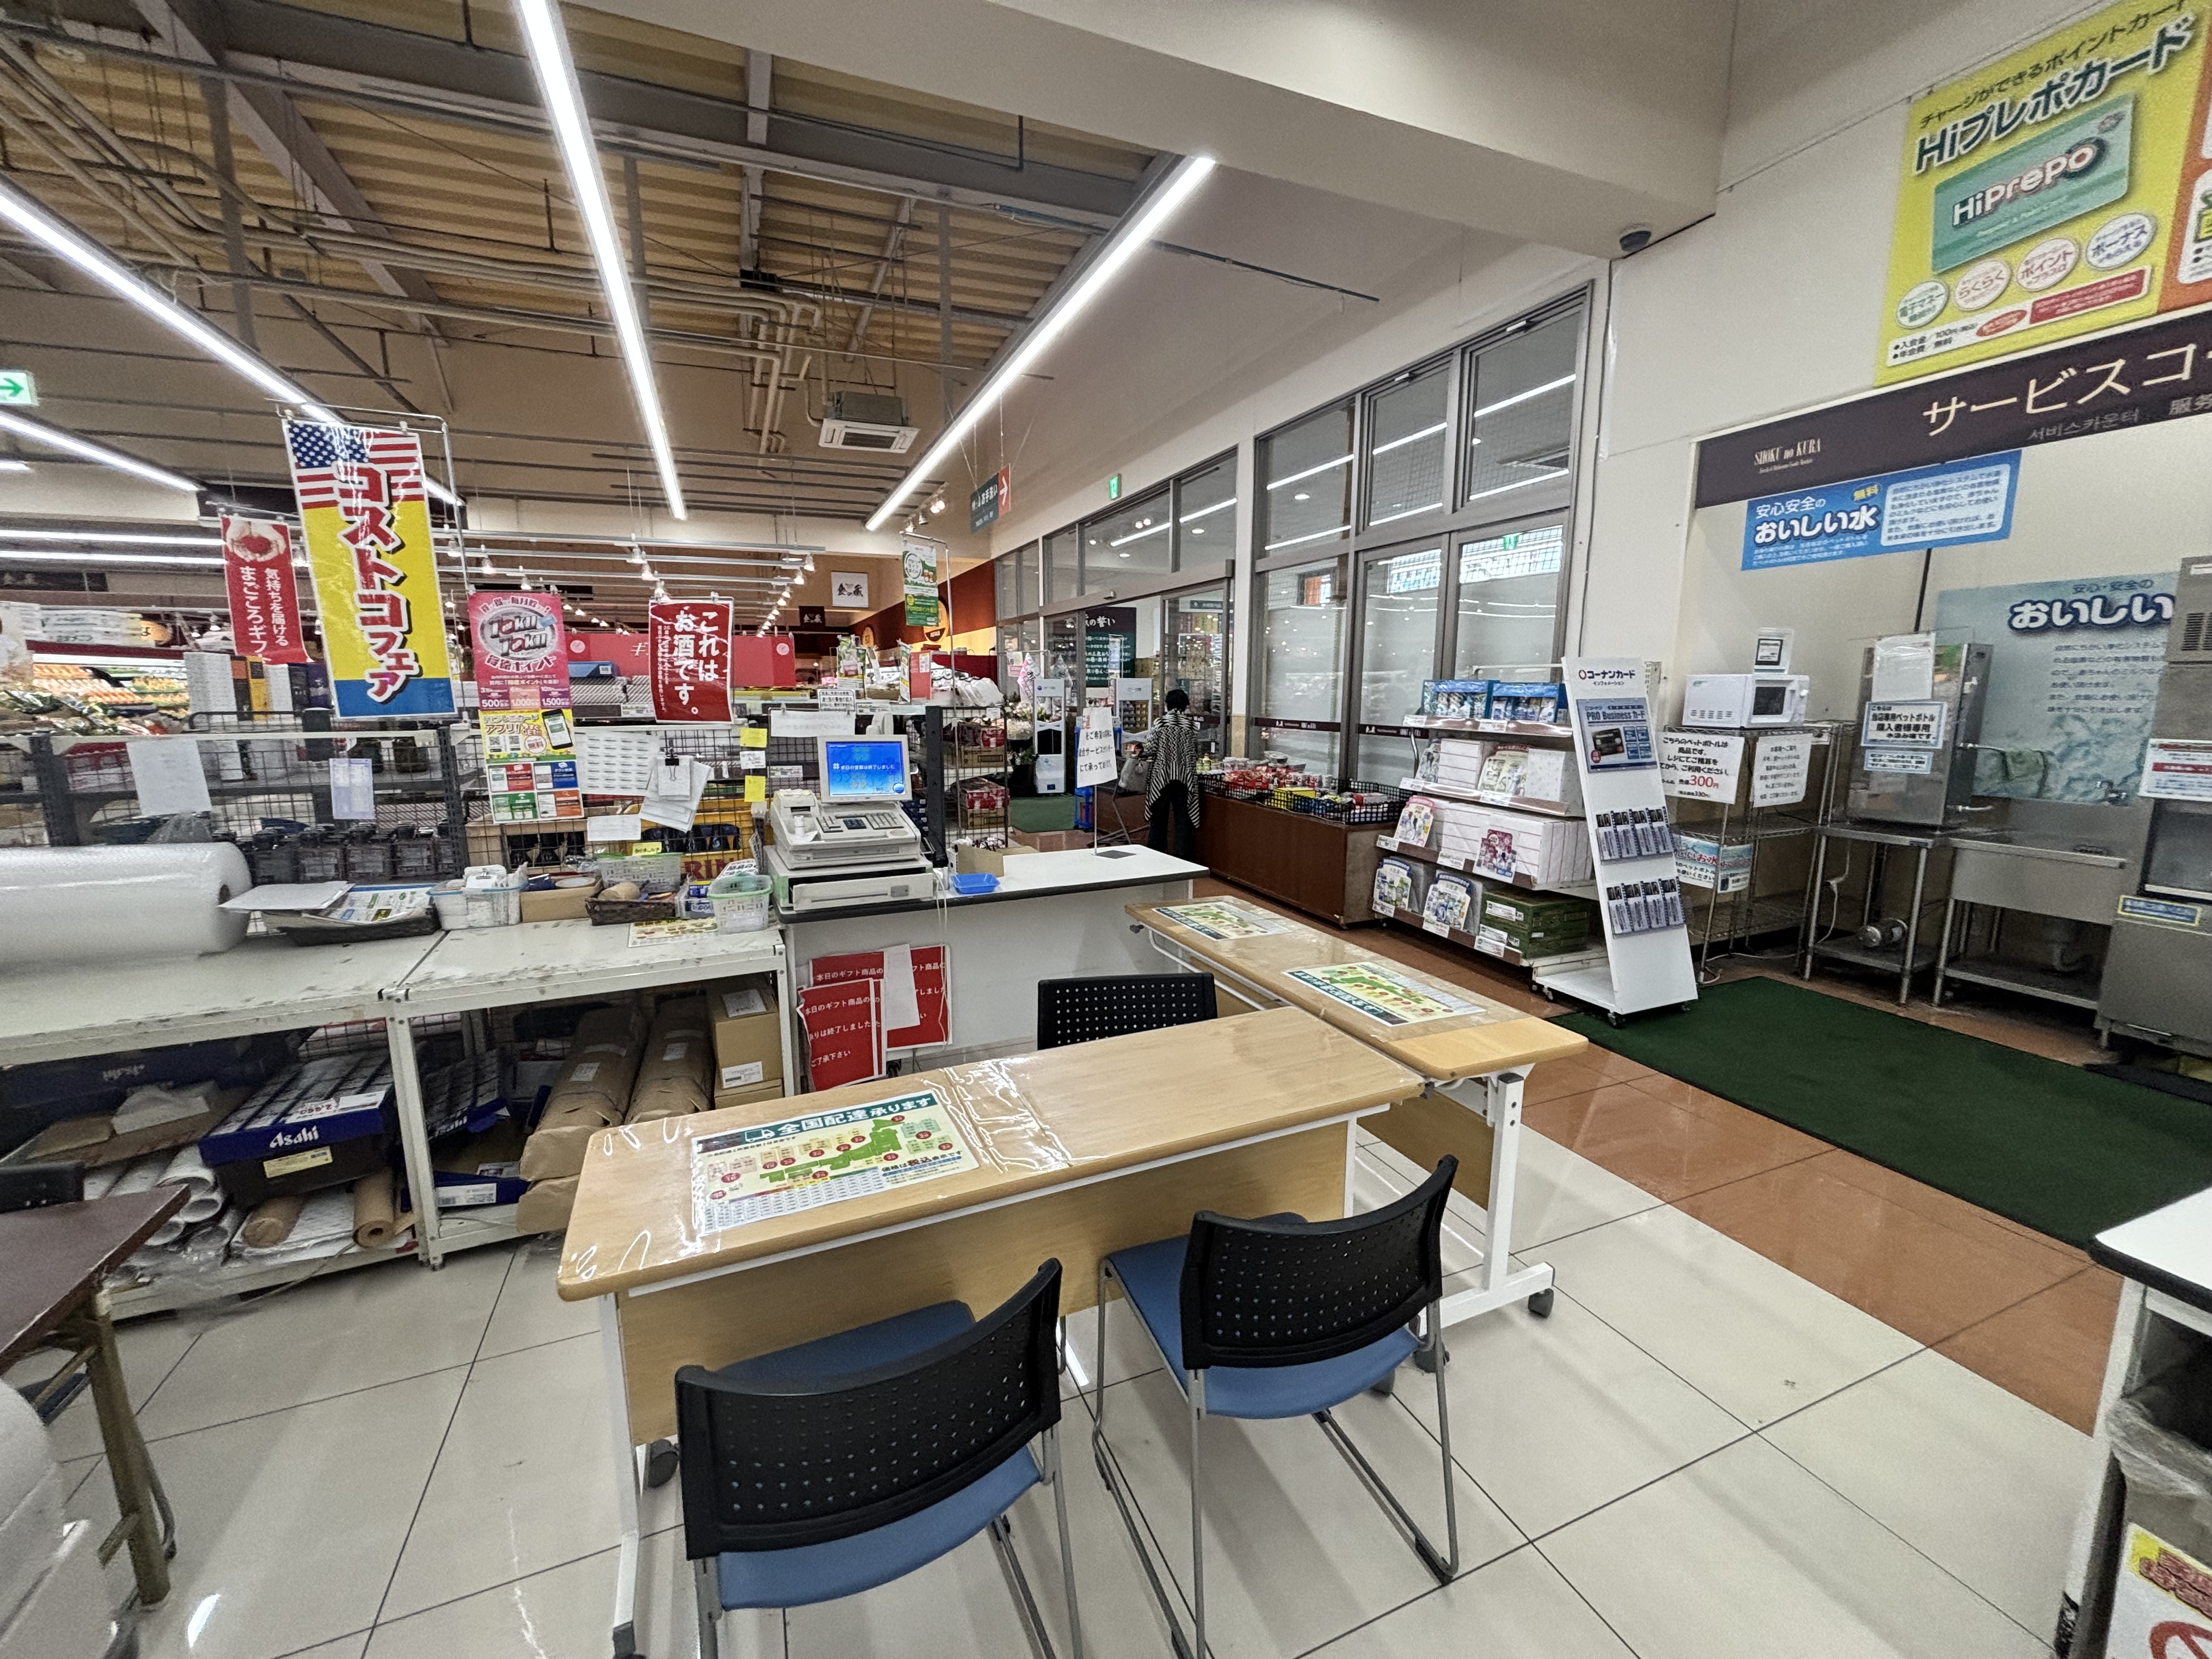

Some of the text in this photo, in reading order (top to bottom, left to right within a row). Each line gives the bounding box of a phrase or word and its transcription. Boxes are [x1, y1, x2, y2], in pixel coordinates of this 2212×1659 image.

[2019, 251, 2074, 280] ポイント
[1923, 344, 2212, 436] サービスコ
[1756, 496, 1826, 519] 安心安全の
[1755, 505, 1877, 544] おいしい水
[337, 463, 417, 701] コストコフェア
[264, 567, 289, 646] 気持ちを届ける
[2011, 596, 2174, 628] おいしい
[698, 611, 720, 681] これは
[674, 610, 699, 715] お酒です。
[1587, 669, 1635, 680] コーナンカード
[1587, 712, 1601, 721] PRO
[1602, 711, 1632, 720] Business
[1663, 737, 1728, 748] こちらのペットボトルは
[1678, 747, 1707, 756] 商品です。
[816, 968, 884, 982] 本日のギフト商品の
[804, 996, 870, 1015] 本日のギフト商品の
[810, 1049, 851, 1067] ご了承下さい
[777, 1096, 932, 1137] 全国配達承ります
[269, 1125, 319, 1149] Asahi
